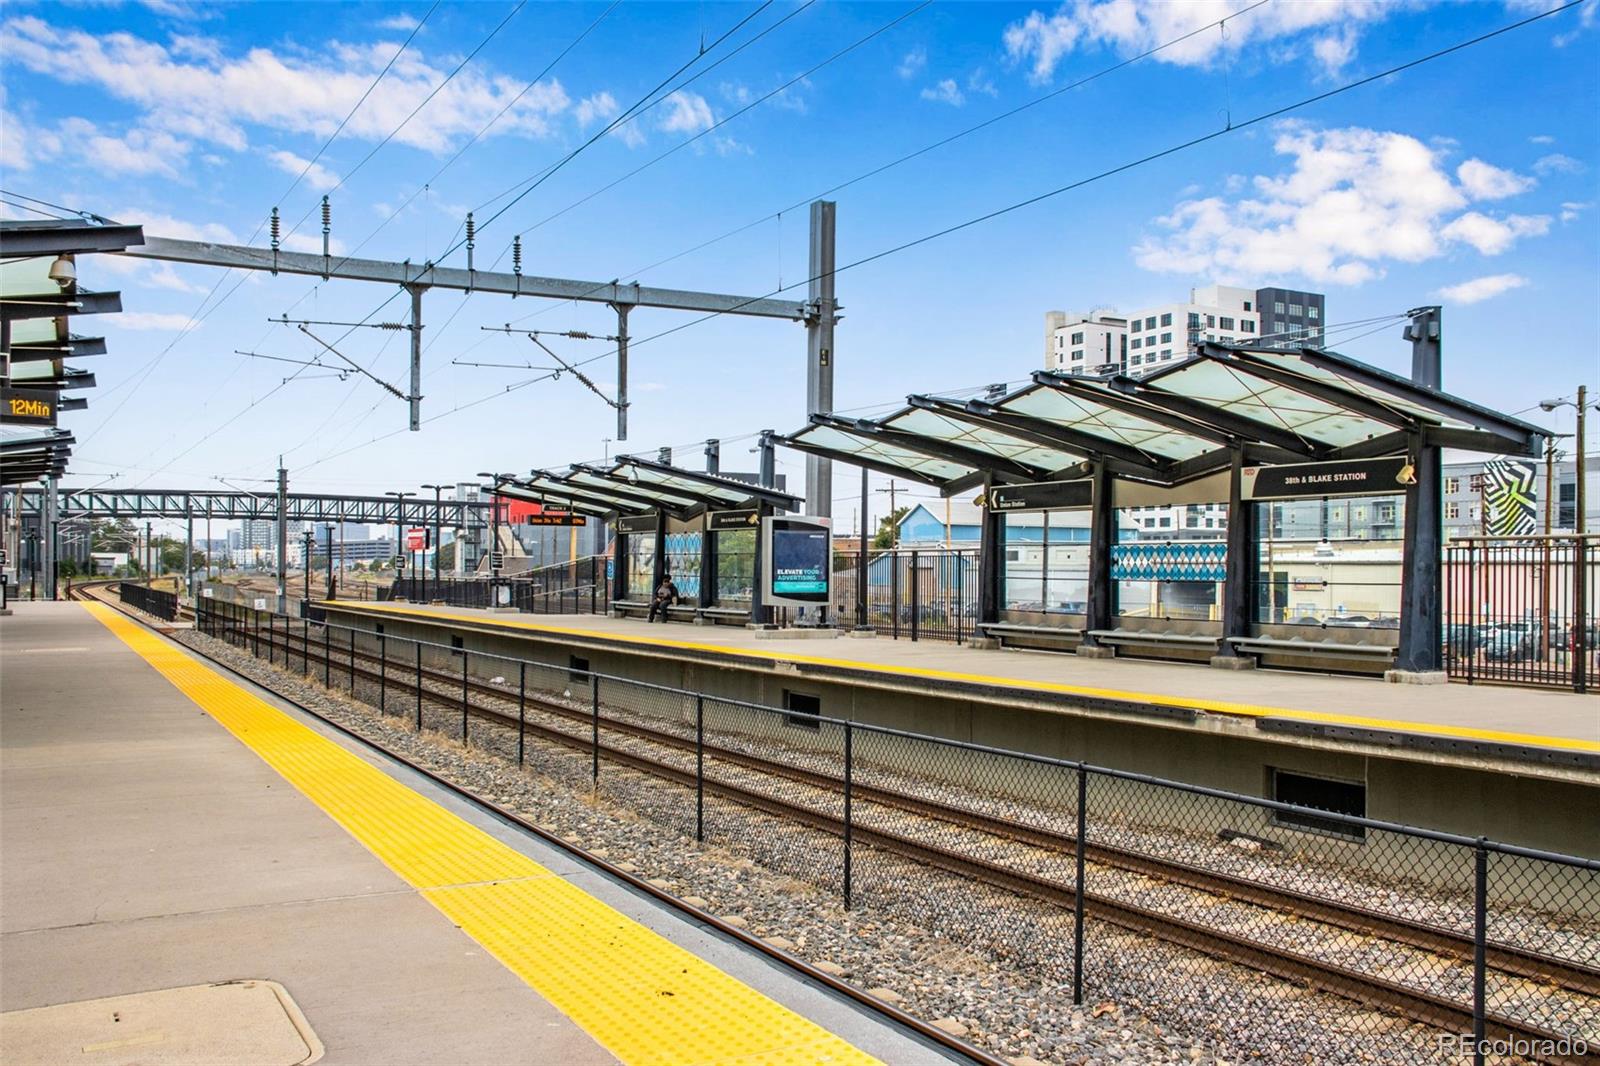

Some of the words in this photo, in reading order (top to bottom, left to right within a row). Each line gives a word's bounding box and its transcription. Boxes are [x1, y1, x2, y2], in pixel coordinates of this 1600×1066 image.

[9, 399, 50, 417] 12Min
[1285, 476, 1300, 485] 38th
[1301, 475, 1307, 484] &
[1308, 474, 1333, 484] BLAKE
[1333, 472, 1367, 482] STATION
